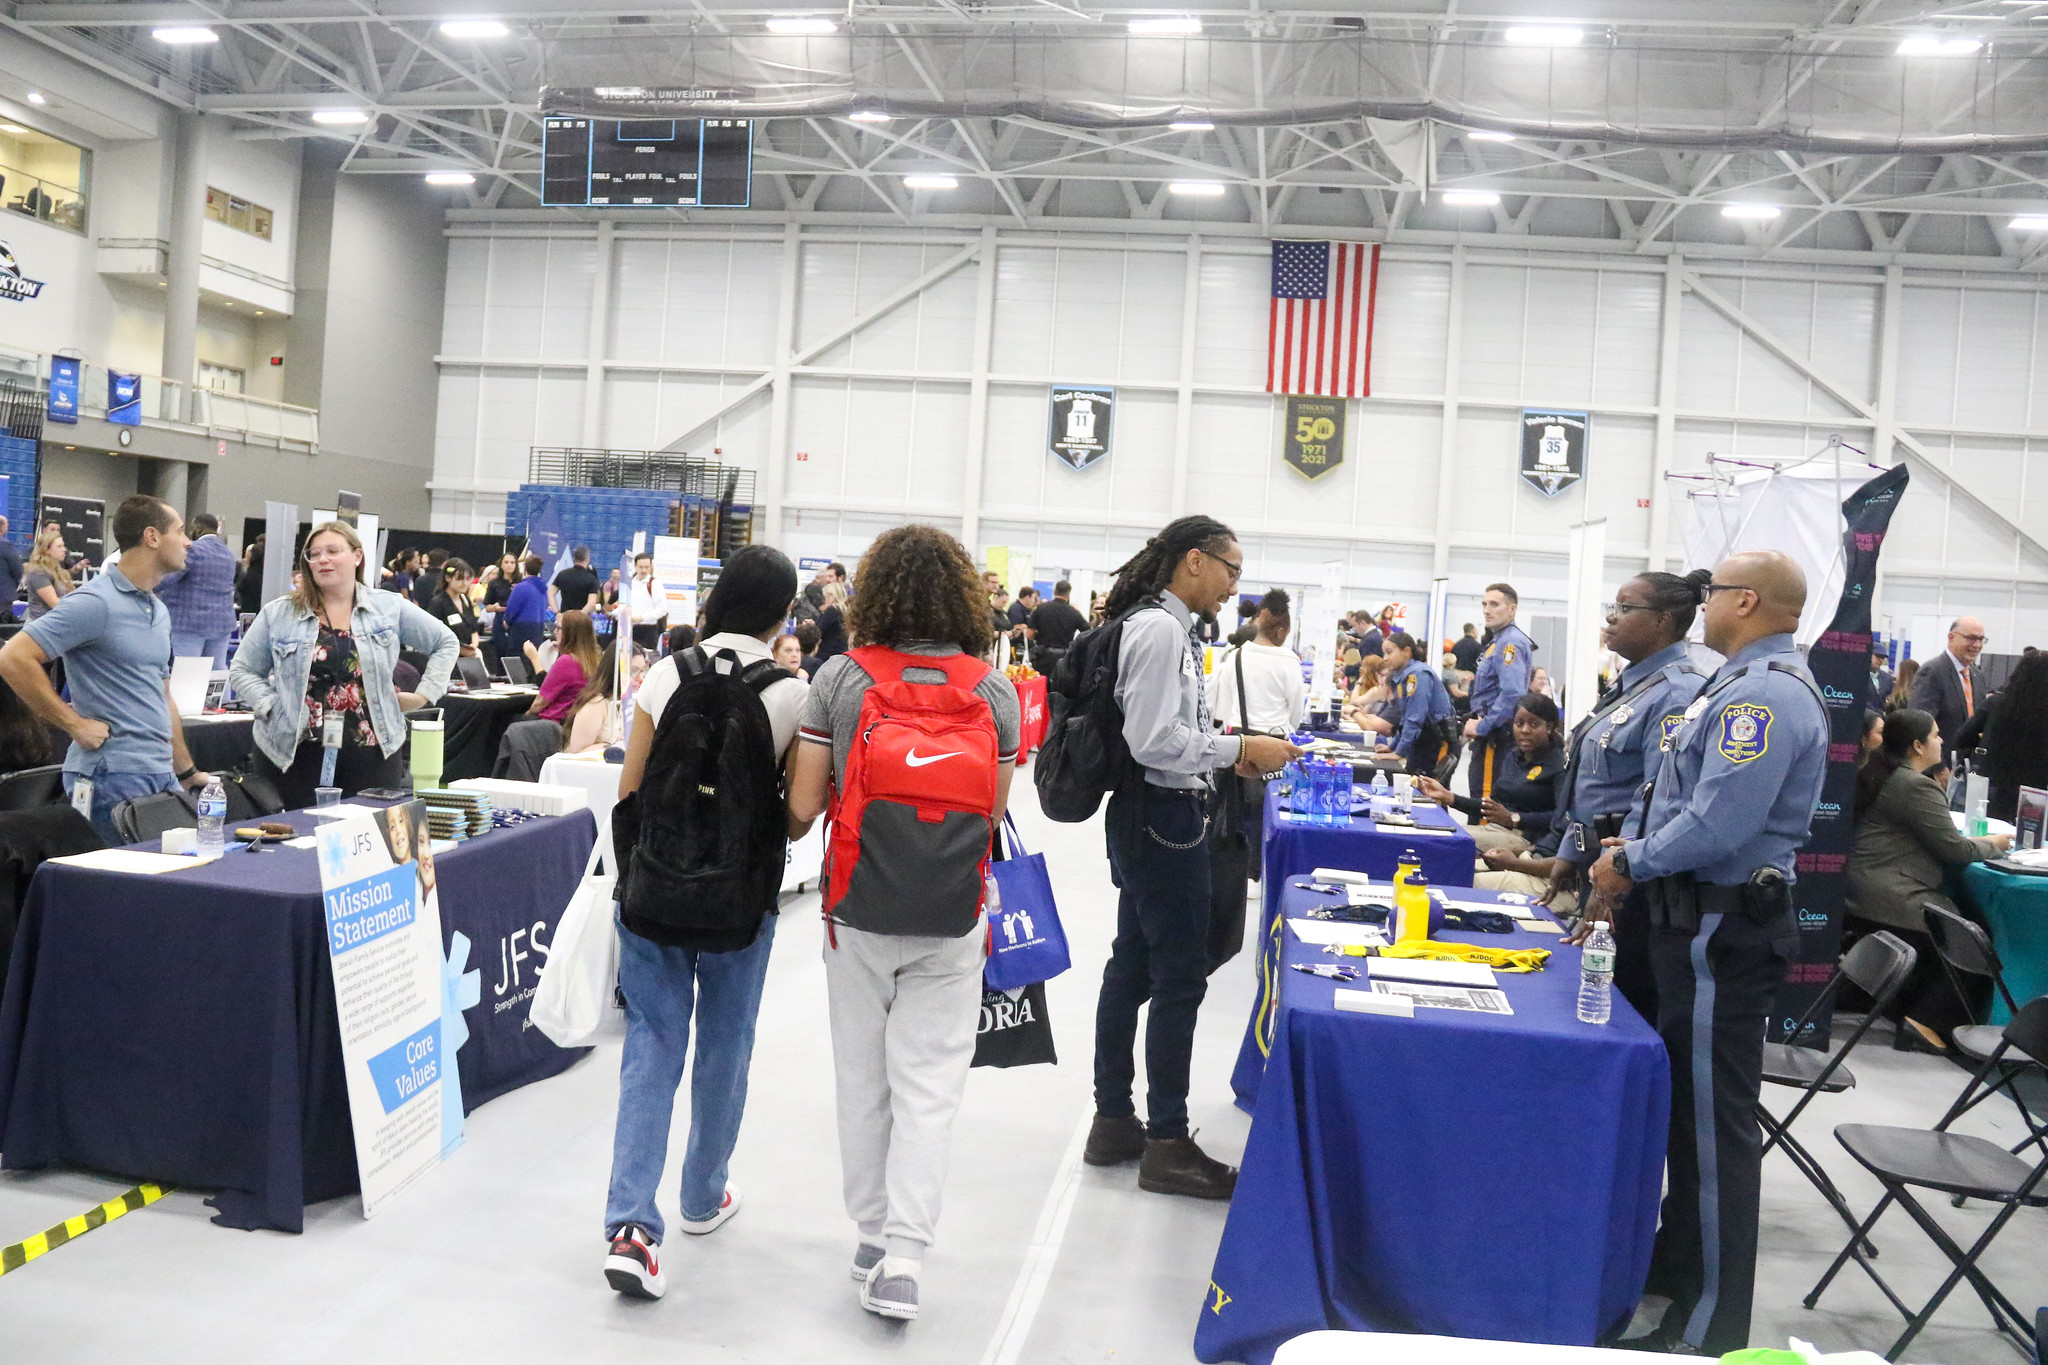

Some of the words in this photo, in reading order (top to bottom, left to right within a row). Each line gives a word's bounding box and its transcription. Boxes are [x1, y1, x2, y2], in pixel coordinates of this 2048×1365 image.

[1076, 415, 1086, 426] 11
[1302, 444, 1326, 455] 1971
[1546, 441, 1560, 454] 35
[1301, 455, 1326, 464] 2021
[1824, 685, 1854, 700] Ocean
[1726, 708, 1767, 720] POLICE
[698, 784, 715, 795] PINK
[352, 832, 372, 856] JFS
[329, 880, 393, 922] Mission
[1799, 908, 1828, 921] Ocean
[334, 898, 412, 950] Statement
[494, 920, 551, 996] JFS
[1470, 954, 1494, 962] NJDOC
[494, 994, 518, 1014] Strength
[518, 992, 524, 1000] in
[406, 1035, 434, 1064] Core
[396, 1060, 437, 1099] Values
